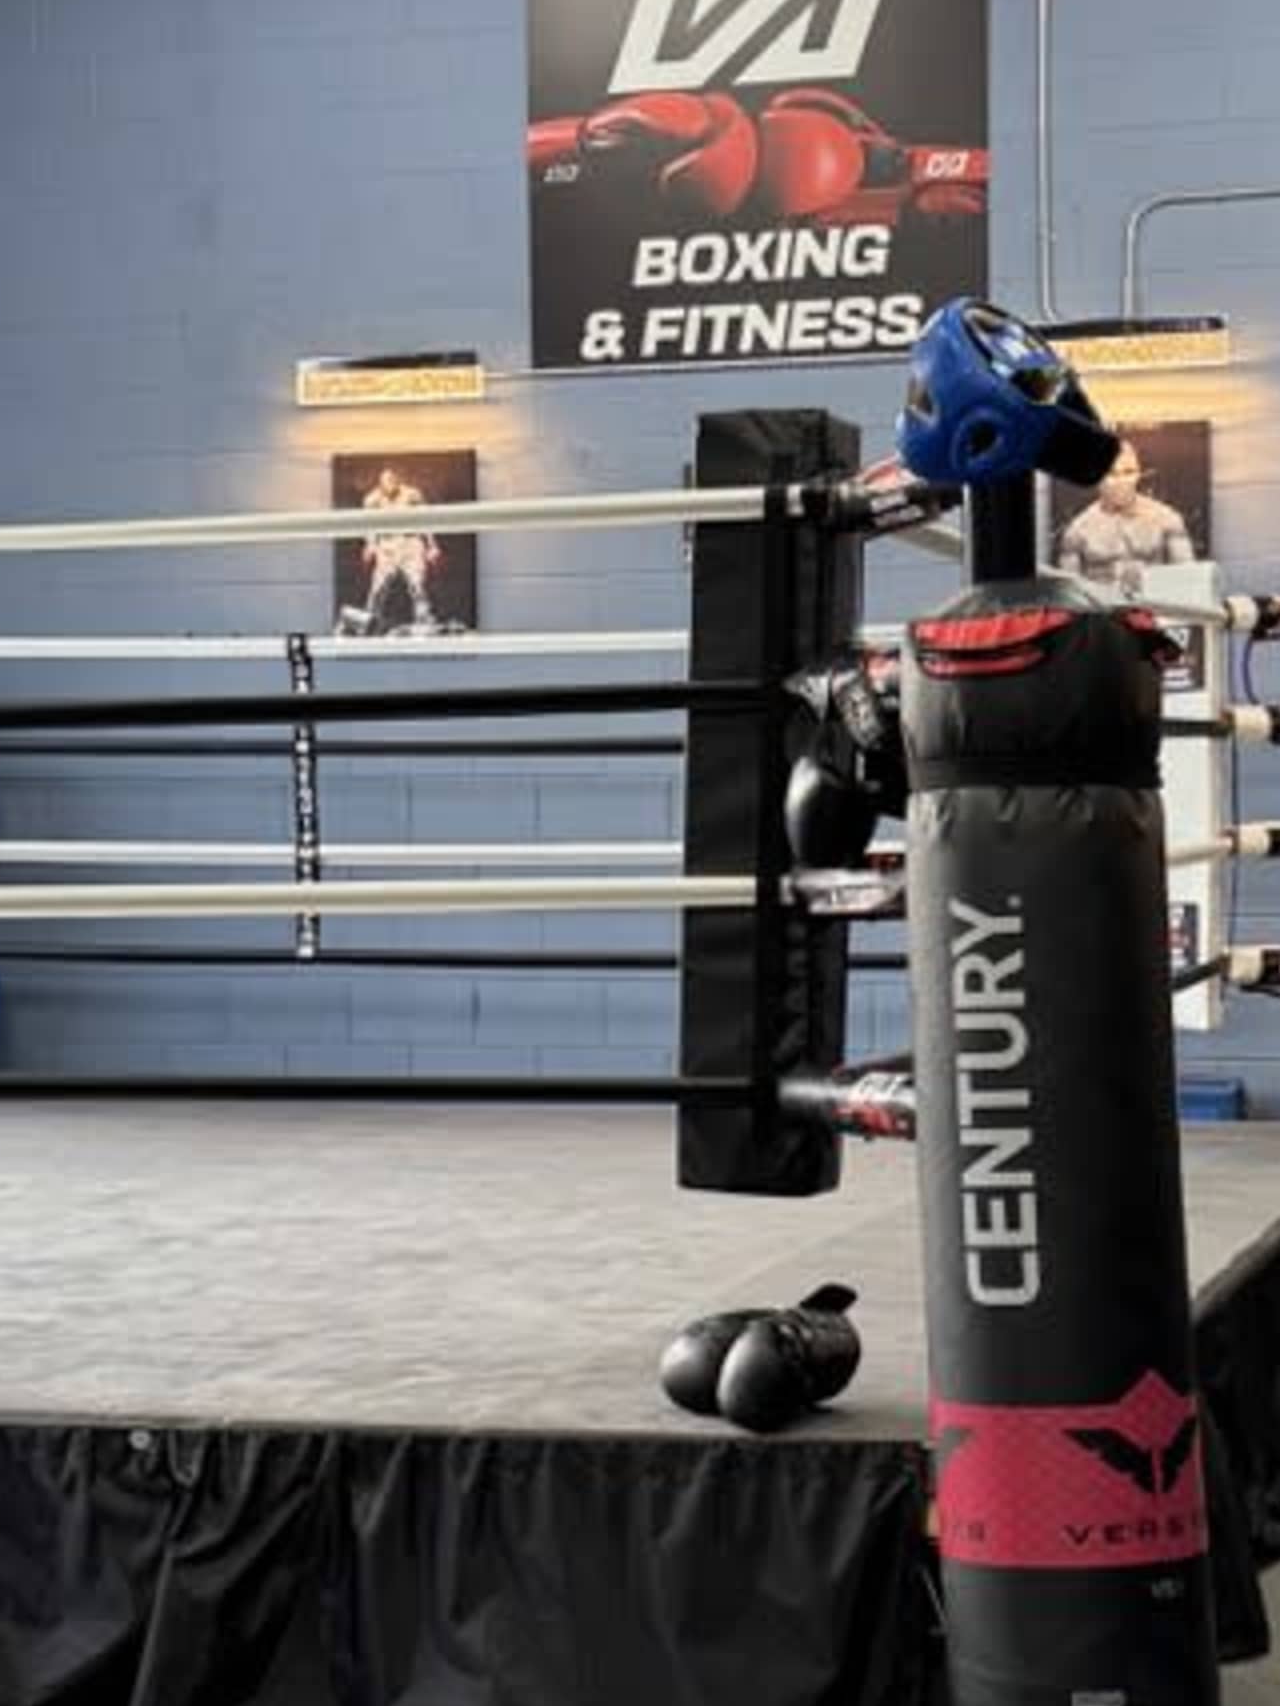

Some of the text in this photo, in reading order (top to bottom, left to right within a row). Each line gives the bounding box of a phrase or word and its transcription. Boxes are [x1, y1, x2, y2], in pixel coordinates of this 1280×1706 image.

[633, 224, 890, 288] BOXING
[580, 294, 924, 362] & FITNESS
